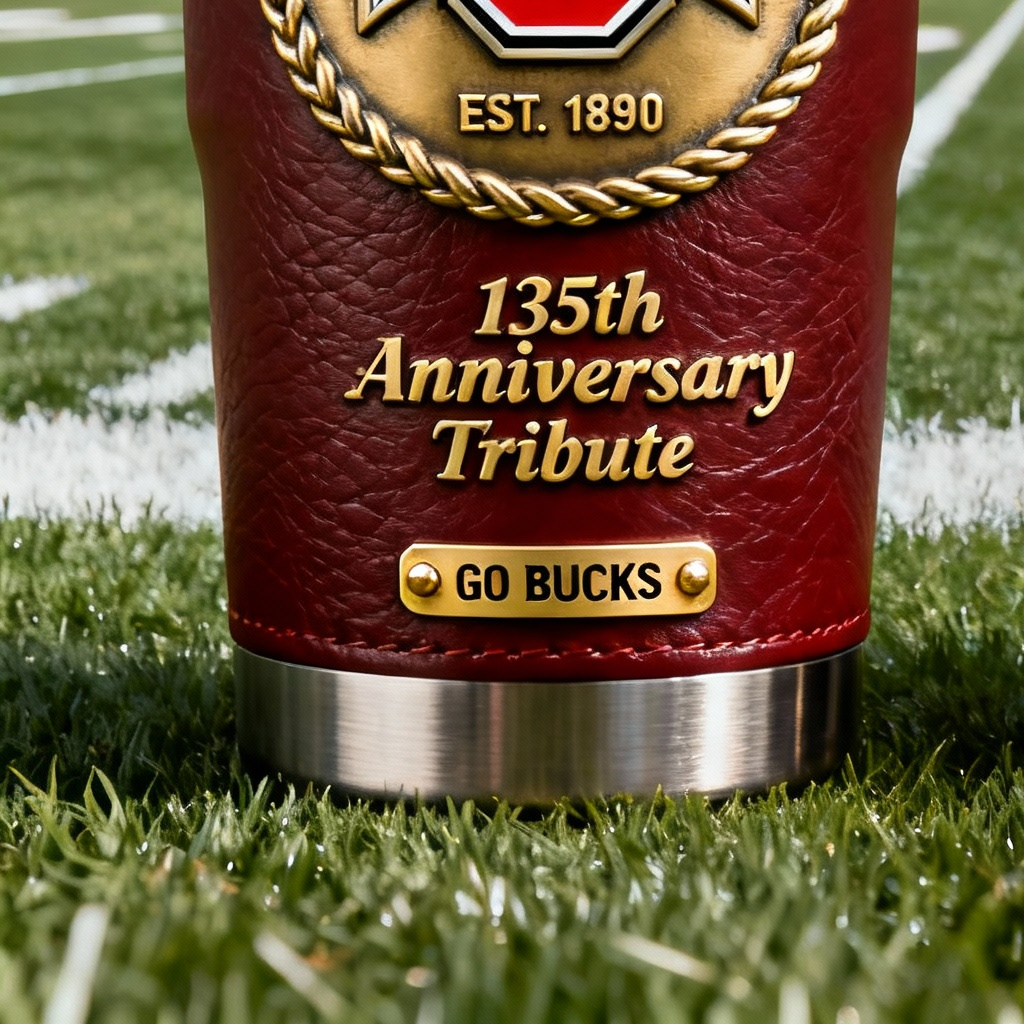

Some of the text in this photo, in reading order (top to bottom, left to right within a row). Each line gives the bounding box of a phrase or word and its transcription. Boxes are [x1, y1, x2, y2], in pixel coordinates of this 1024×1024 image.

[458, 92, 665, 133] EST. 1890
[474, 270, 665, 336] 135th
[343, 337, 796, 418] Anniversary
[432, 418, 695, 483] Tribute
[456, 562, 662, 603] GO BUCKS
